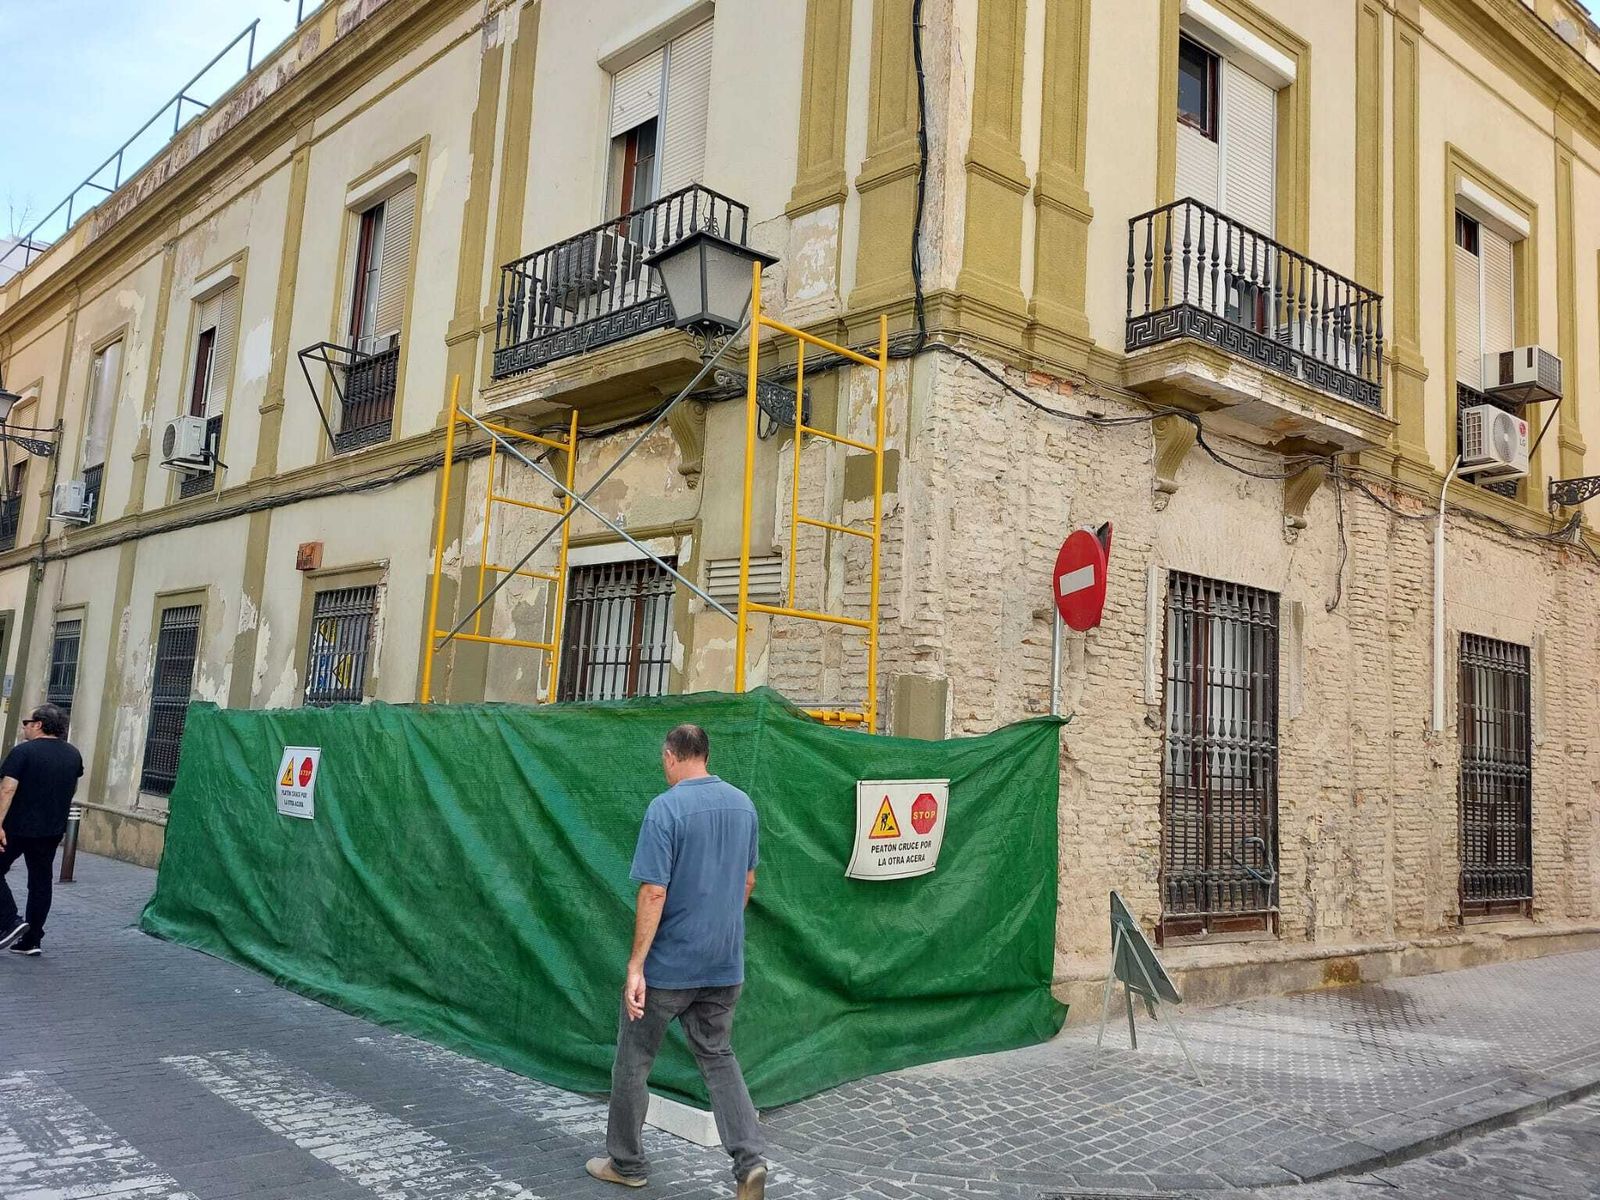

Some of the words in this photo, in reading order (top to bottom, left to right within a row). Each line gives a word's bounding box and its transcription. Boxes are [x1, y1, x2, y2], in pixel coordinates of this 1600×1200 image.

[913, 811, 936, 820] STOP
[898, 841, 919, 851] CRUCE
[920, 840, 931, 849] POR
[878, 858, 886, 866] LA
[888, 855, 904, 865] OTRA
[906, 854, 925, 863] ACERA
